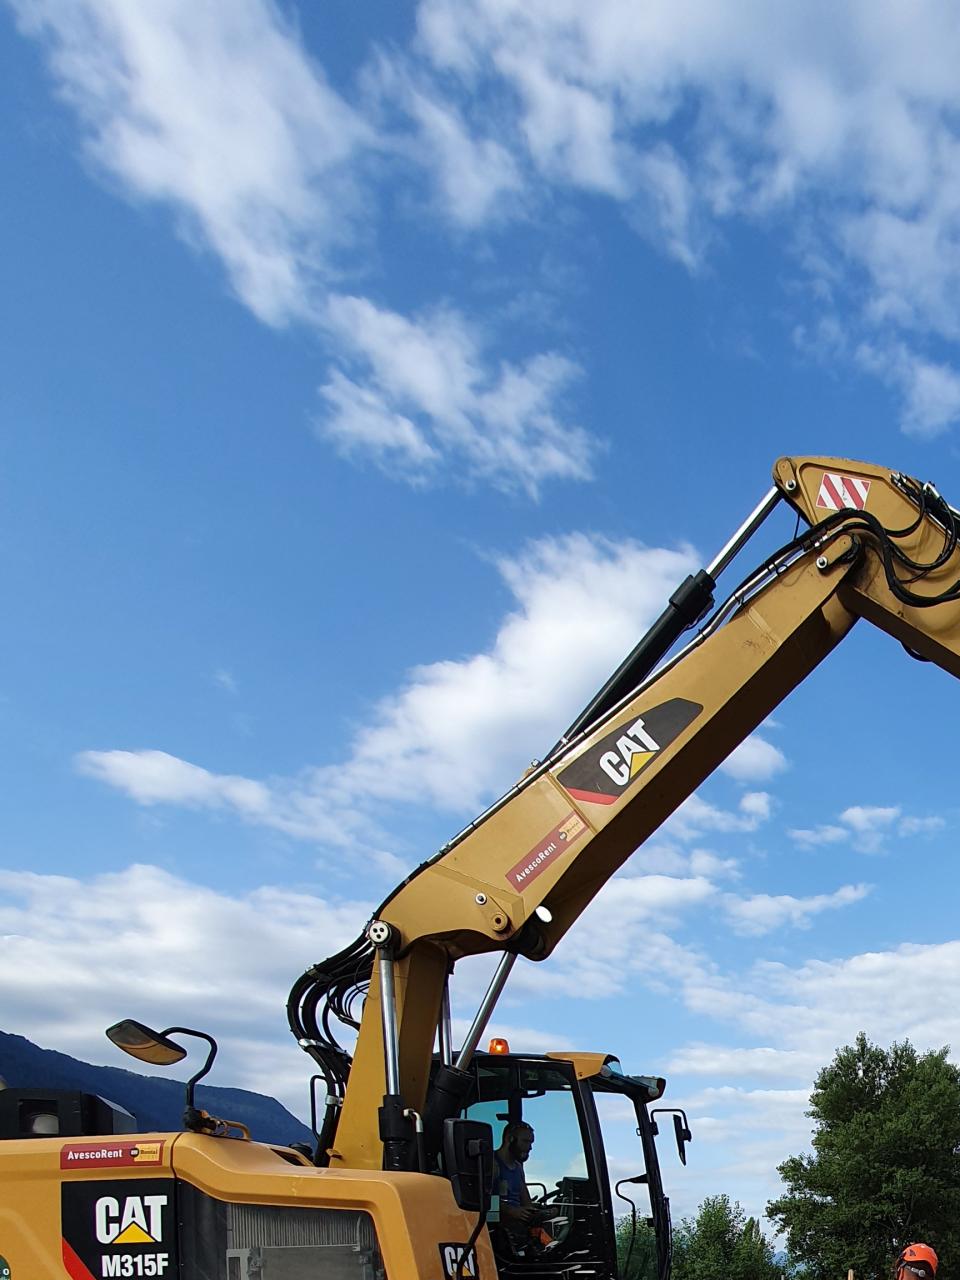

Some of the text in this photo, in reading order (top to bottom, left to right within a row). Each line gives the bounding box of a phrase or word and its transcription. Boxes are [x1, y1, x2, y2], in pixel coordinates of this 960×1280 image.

[599, 718, 661, 786] CAT
[515, 842, 557, 883] AvescoRent
[67, 1149, 123, 1160] AvescoRent
[95, 1195, 168, 1244] CAT
[101, 1253, 169, 1277] M315F
